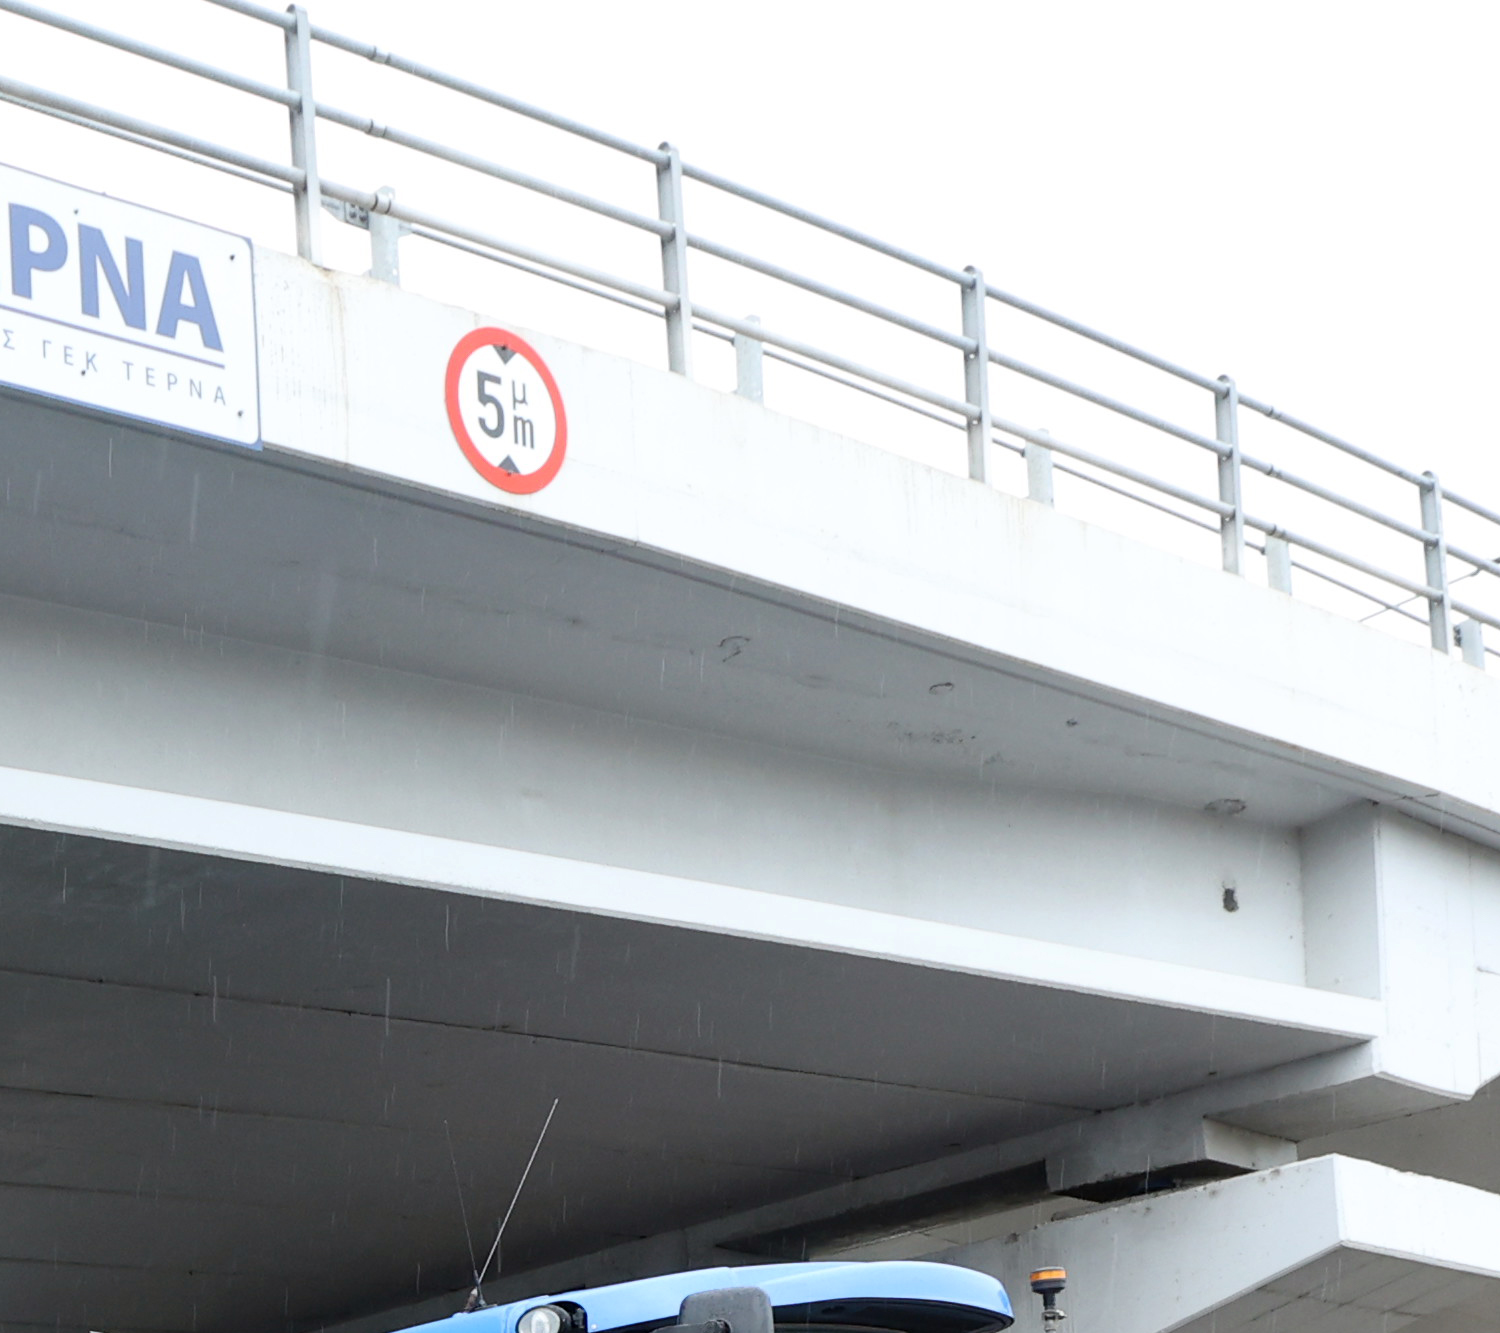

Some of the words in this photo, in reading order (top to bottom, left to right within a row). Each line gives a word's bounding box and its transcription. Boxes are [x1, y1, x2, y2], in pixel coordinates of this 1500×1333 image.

[42, 339, 99, 373] ΓΕΚ
[122, 360, 226, 406] ΤΕΡΝΑ
[476, 370, 505, 439] 5
[513, 414, 535, 450] m
